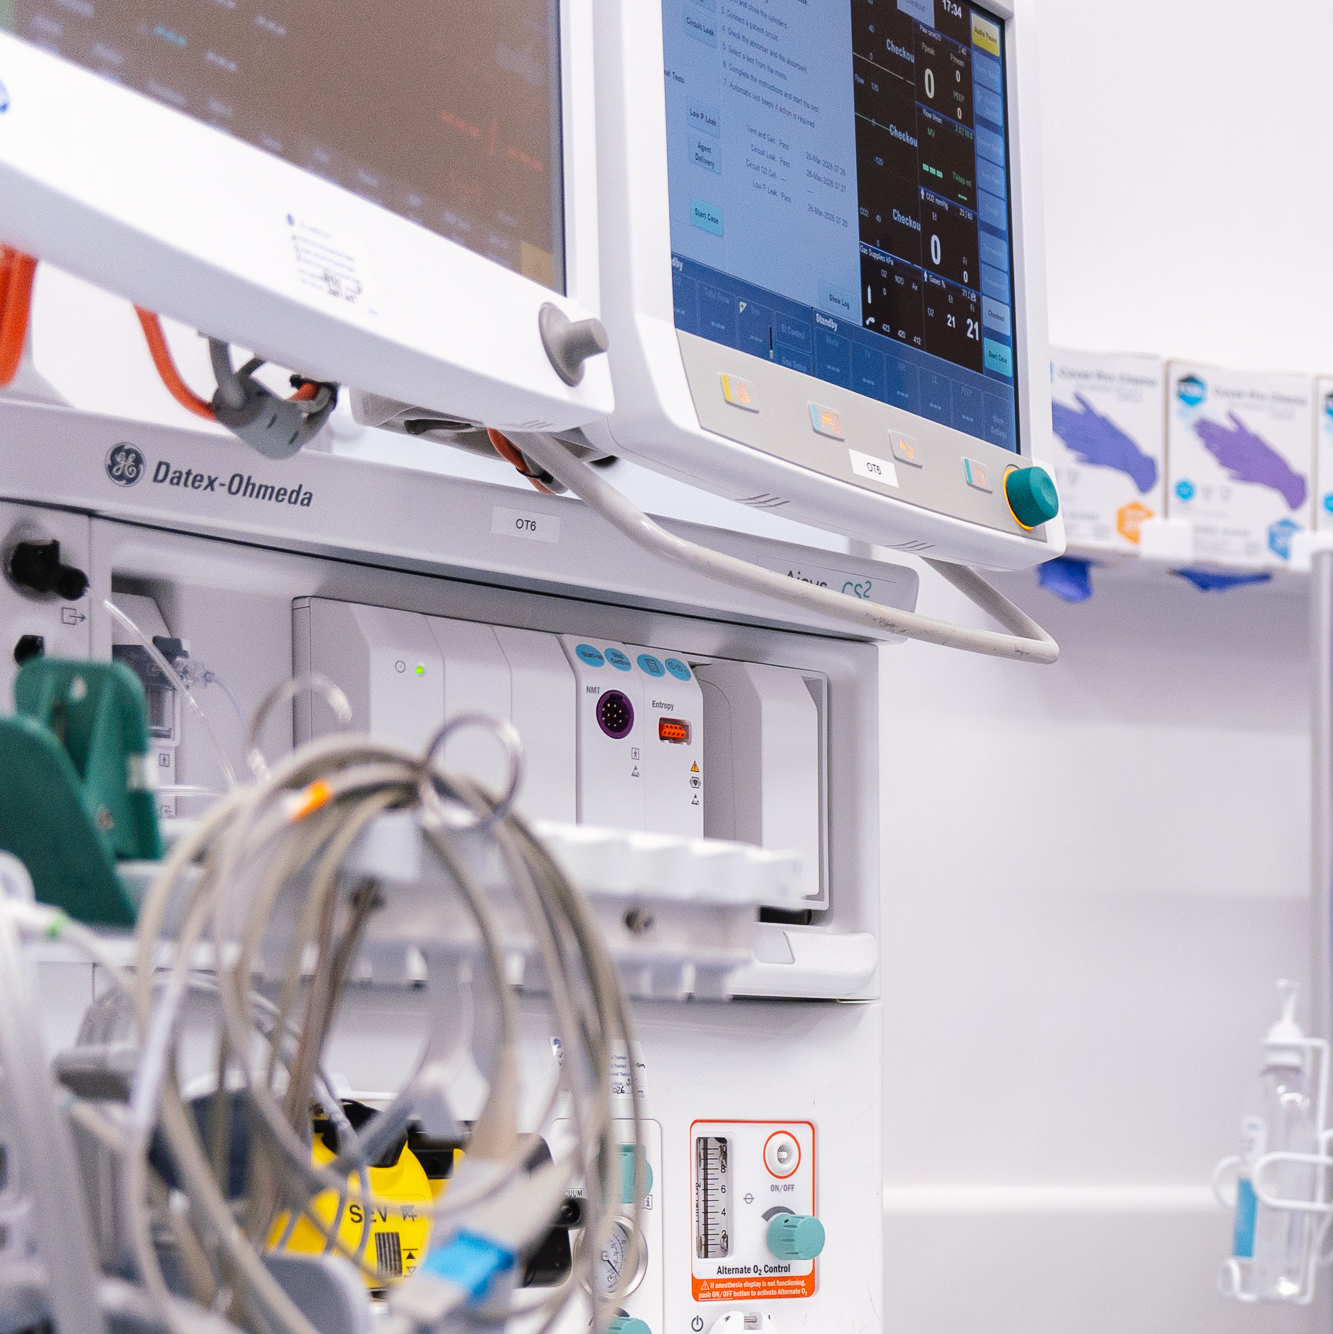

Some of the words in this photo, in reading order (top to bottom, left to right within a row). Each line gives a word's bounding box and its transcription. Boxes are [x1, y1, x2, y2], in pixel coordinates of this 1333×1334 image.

[686, 16, 702, 31] Circuit
[703, 25, 715, 36] Leak
[955, 70, 961, 83] 0
[924, 68, 935, 99] 0
[690, 108, 700, 119] Low
[956, 107, 962, 120] 0
[698, 142, 712, 154] Agent
[695, 152, 715, 170] Delivery
[694, 207, 707, 220] Start
[707, 213, 719, 225] Case
[930, 234, 941, 265] 0
[963, 270, 968, 283] 0
[815, 313, 838, 332] Standby
[947, 314, 956, 329] 21
[966, 318, 979, 341] 21
[866, 462, 882, 476] OT6
[152, 460, 313, 508] Datex-Ohmeda
[515, 518, 537, 532] OT6
[586, 686, 600, 694] NMT
[651, 700, 675, 711] Entropy
[720, 1185, 727, 1194] 6
[770, 1184, 795, 1193] ON/OFF
[349, 1204, 388, 1224] SV
[720, 1207, 727, 1217] 4
[721, 1229, 727, 1238] 2
[717, 1265, 751, 1275] Alternate
[763, 1263, 791, 1274] Control
[715, 1281, 743, 1289] anesthesia
[743, 1280, 762, 1289] display
[698, 1291, 712, 1299] push
[712, 1290, 733, 1298] ON/OFF
[777, 1288, 801, 1296] Alternate
